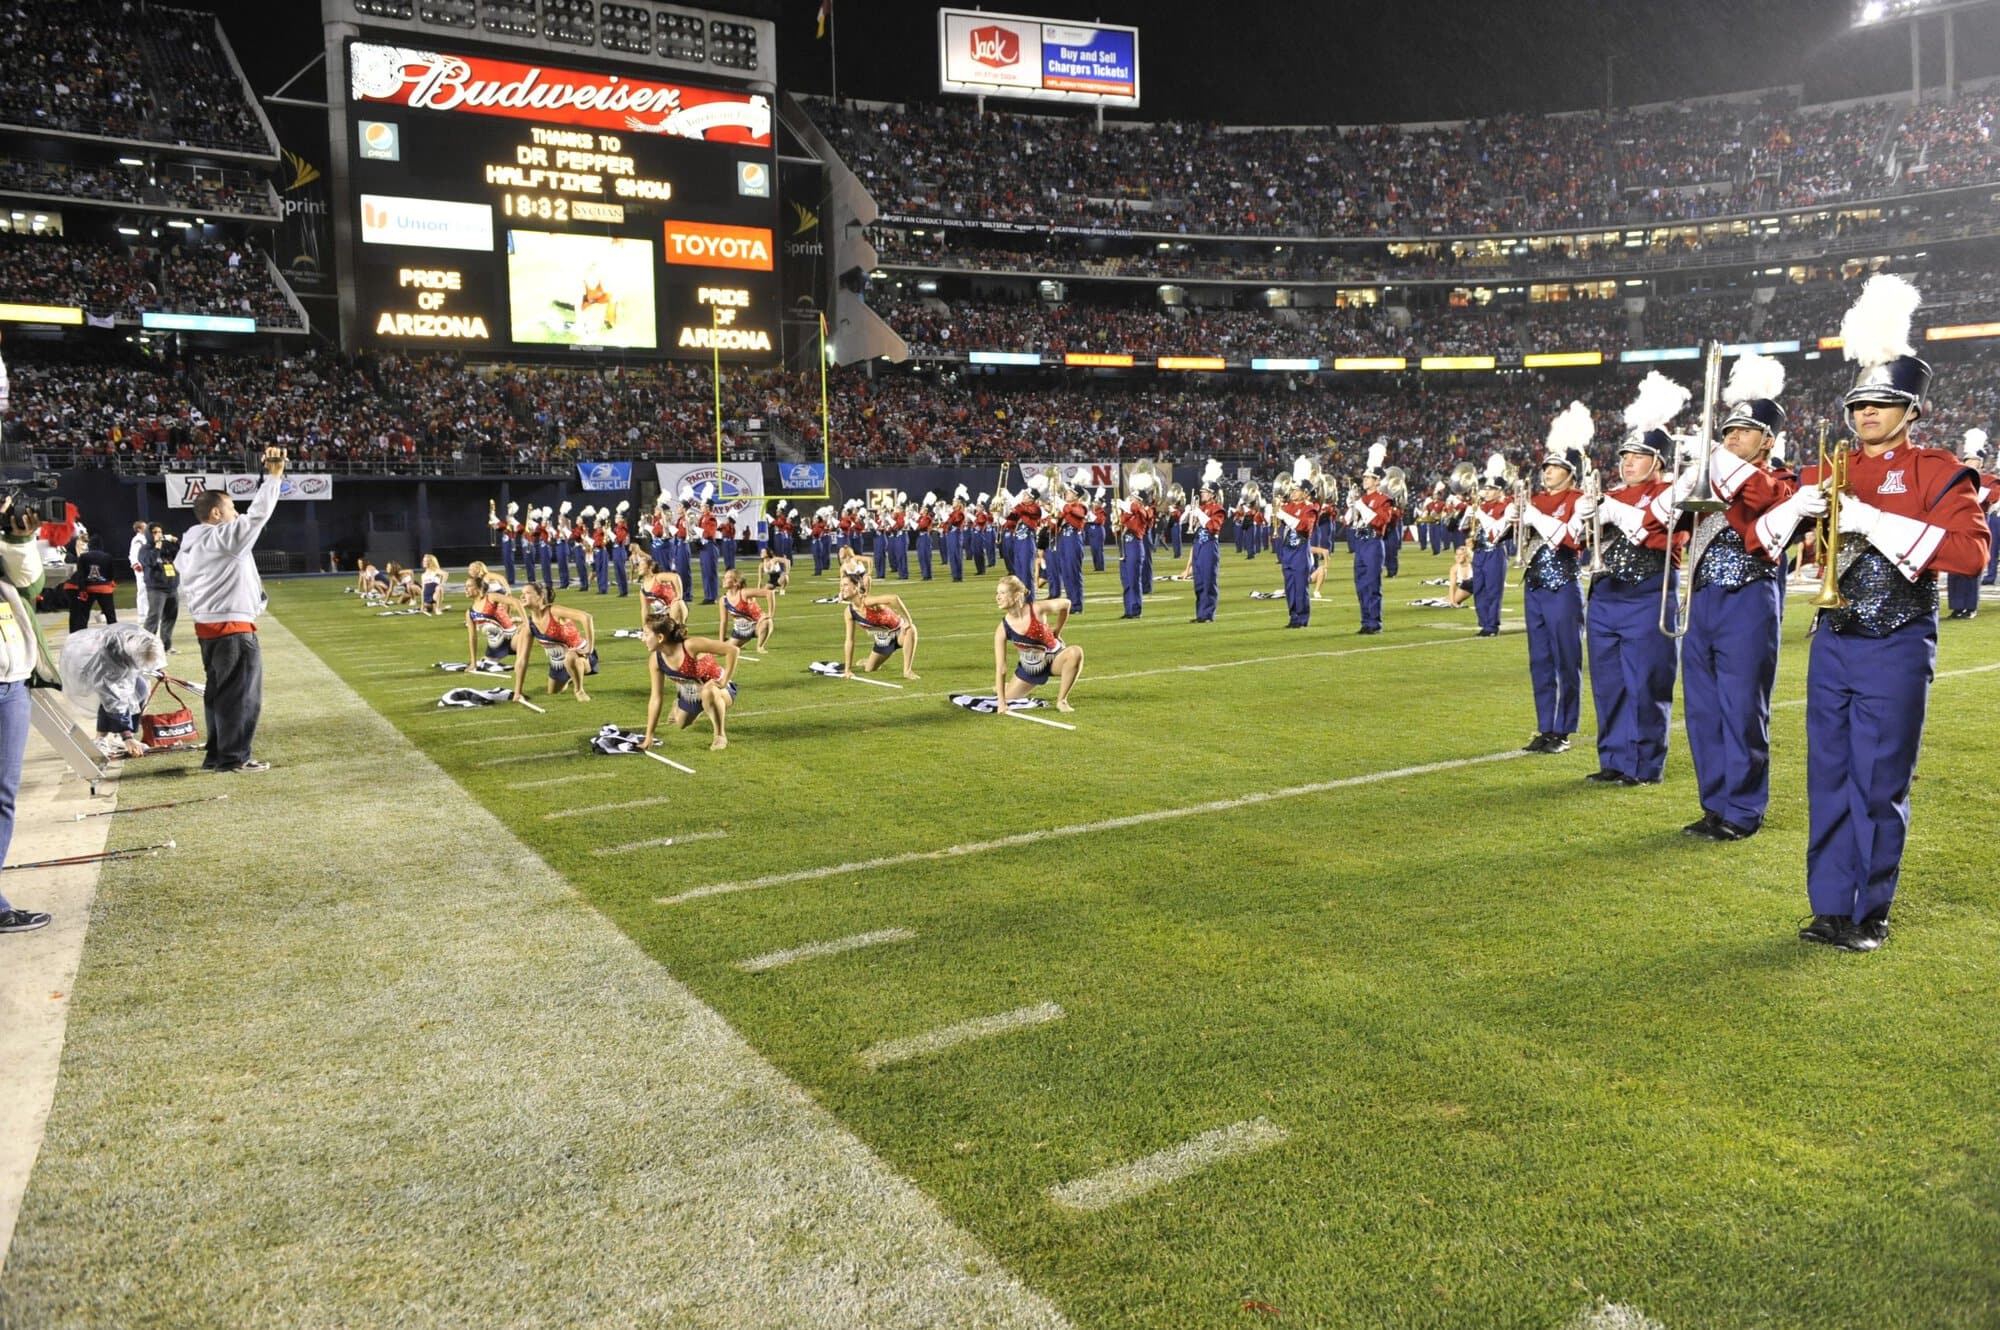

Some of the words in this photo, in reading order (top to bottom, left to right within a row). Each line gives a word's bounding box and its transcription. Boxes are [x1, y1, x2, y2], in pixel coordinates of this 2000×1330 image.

[972, 30, 1018, 63] Jack
[1060, 47, 1078, 63] Buy
[1080, 51, 1097, 62] and
[1099, 50, 1117, 64] Sell
[1048, 59, 1091, 77] Chargers
[1092, 63, 1129, 79] Tickets!
[399, 58, 680, 113] Budweiser
[531, 127, 594, 149] THANKS
[599, 135, 621, 152] TO
[517, 145, 548, 167] DR
[556, 150, 635, 175] PEPPER
[486, 164, 603, 194] HALFTIME
[615, 178, 672, 200] SHOW
[573, 204, 623, 219] SYCUAN
[916, 216, 942, 225] CONDUCT
[397, 215, 449, 232] Union
[670, 233, 768, 261] TOYOTA
[784, 240, 824, 257] Sprint
[399, 268, 461, 290] PRIDE
[418, 292, 445, 310] OF
[698, 287, 750, 307] PRIDE
[376, 312, 489, 339] ARIZONA
[714, 308, 736, 325] OF
[679, 327, 771, 351] ARIZONA
[686, 470, 719, 485] PACIFIC
[1091, 465, 1113, 486] N
[1877, 470, 1908, 494] A
[182, 476, 207, 505] A
